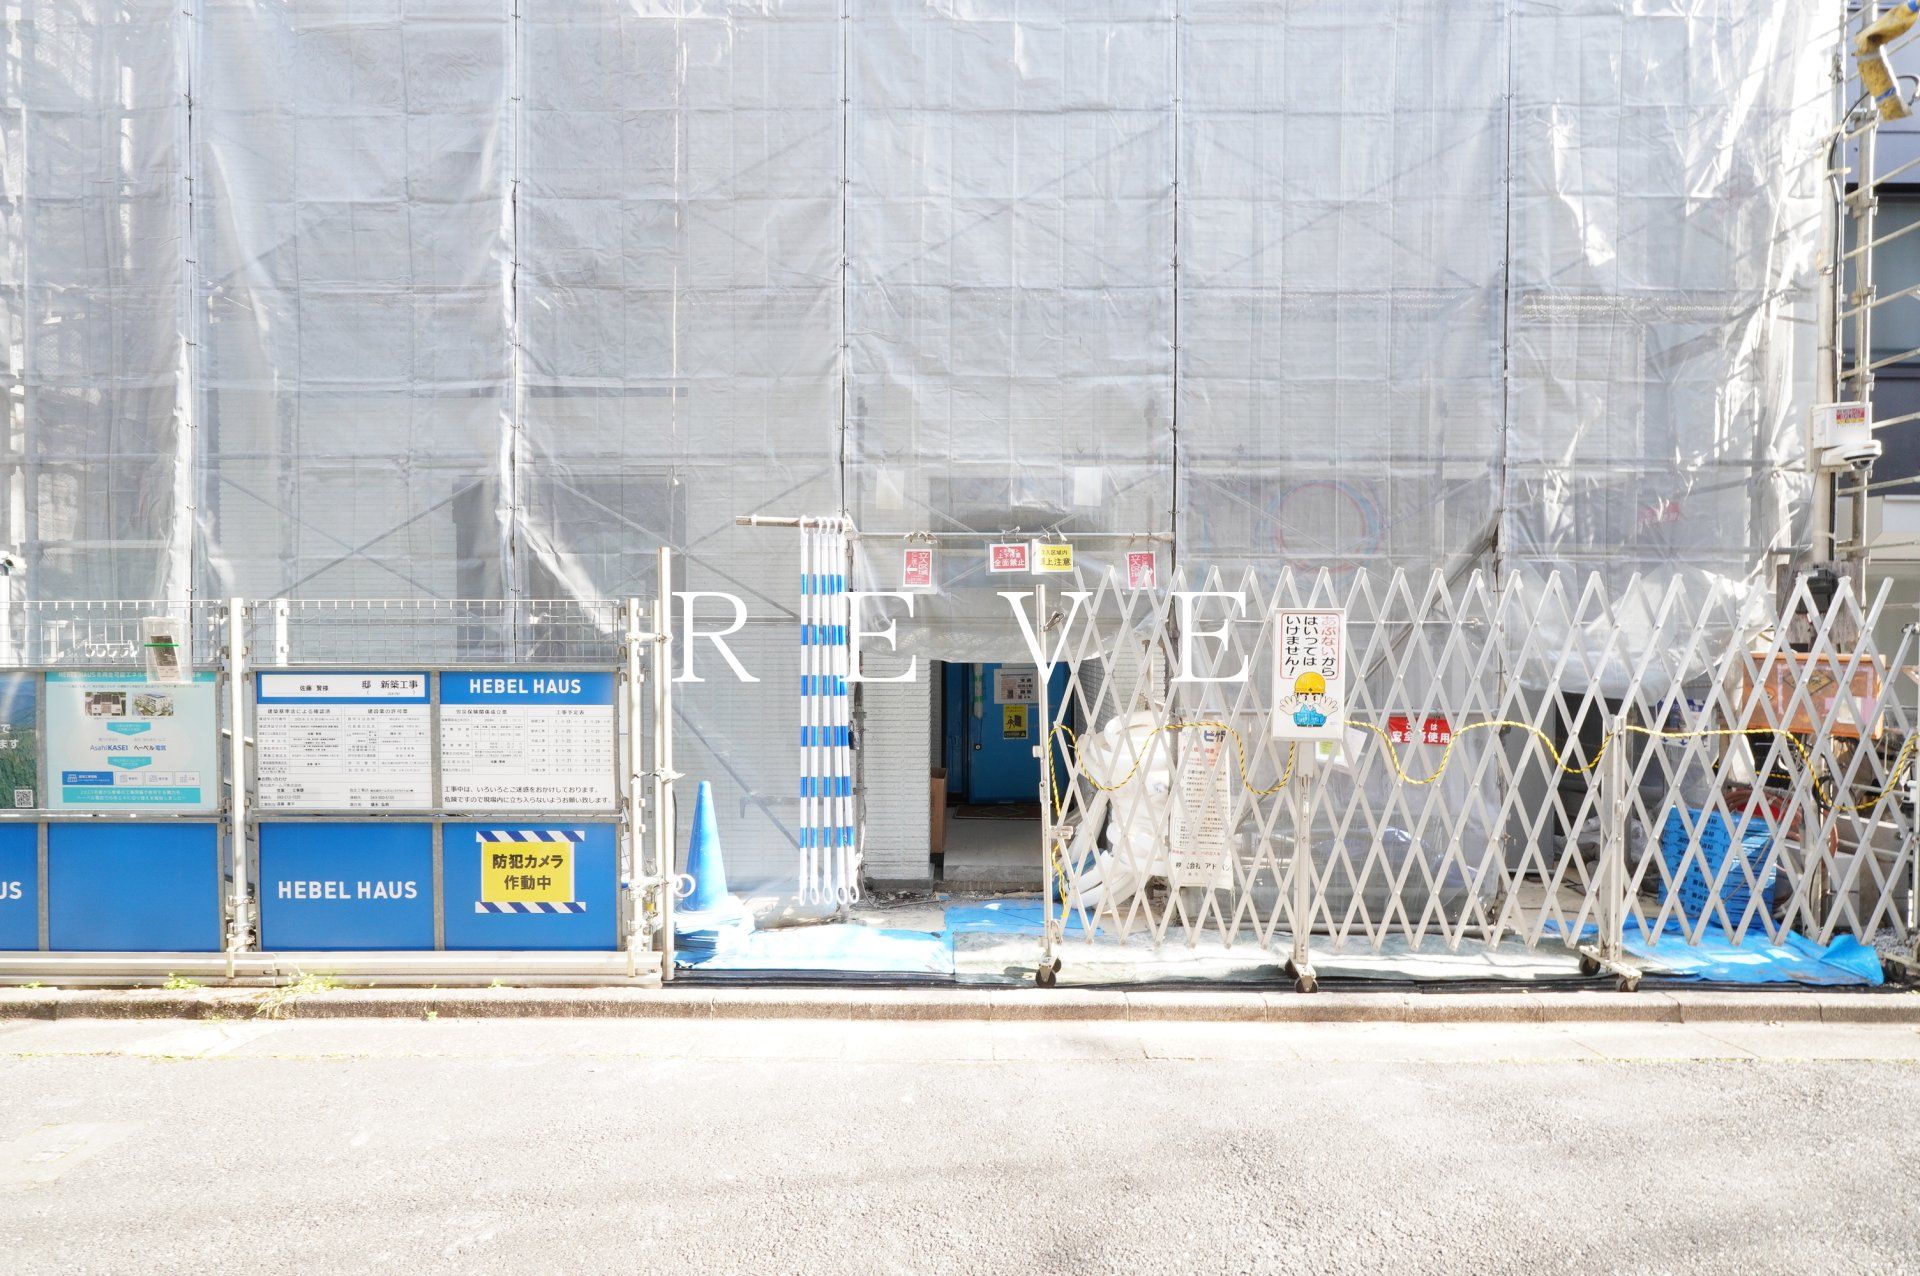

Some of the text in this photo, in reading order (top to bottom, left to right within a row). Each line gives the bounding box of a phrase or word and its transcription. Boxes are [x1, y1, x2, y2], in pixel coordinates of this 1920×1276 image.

[994, 559, 1025, 567] 全面禁止
[1303, 616, 1318, 667] はいっては
[1321, 616, 1337, 677] あぶないから
[380, 680, 418, 689] 新築工事
[469, 678, 582, 694] HEBEL HAUS
[1391, 731, 1450, 743] 安全使用
[492, 854, 564, 869] 防犯カメラ
[278, 880, 418, 899] HEBEL HAUS
[504, 875, 552, 890] 作動中
